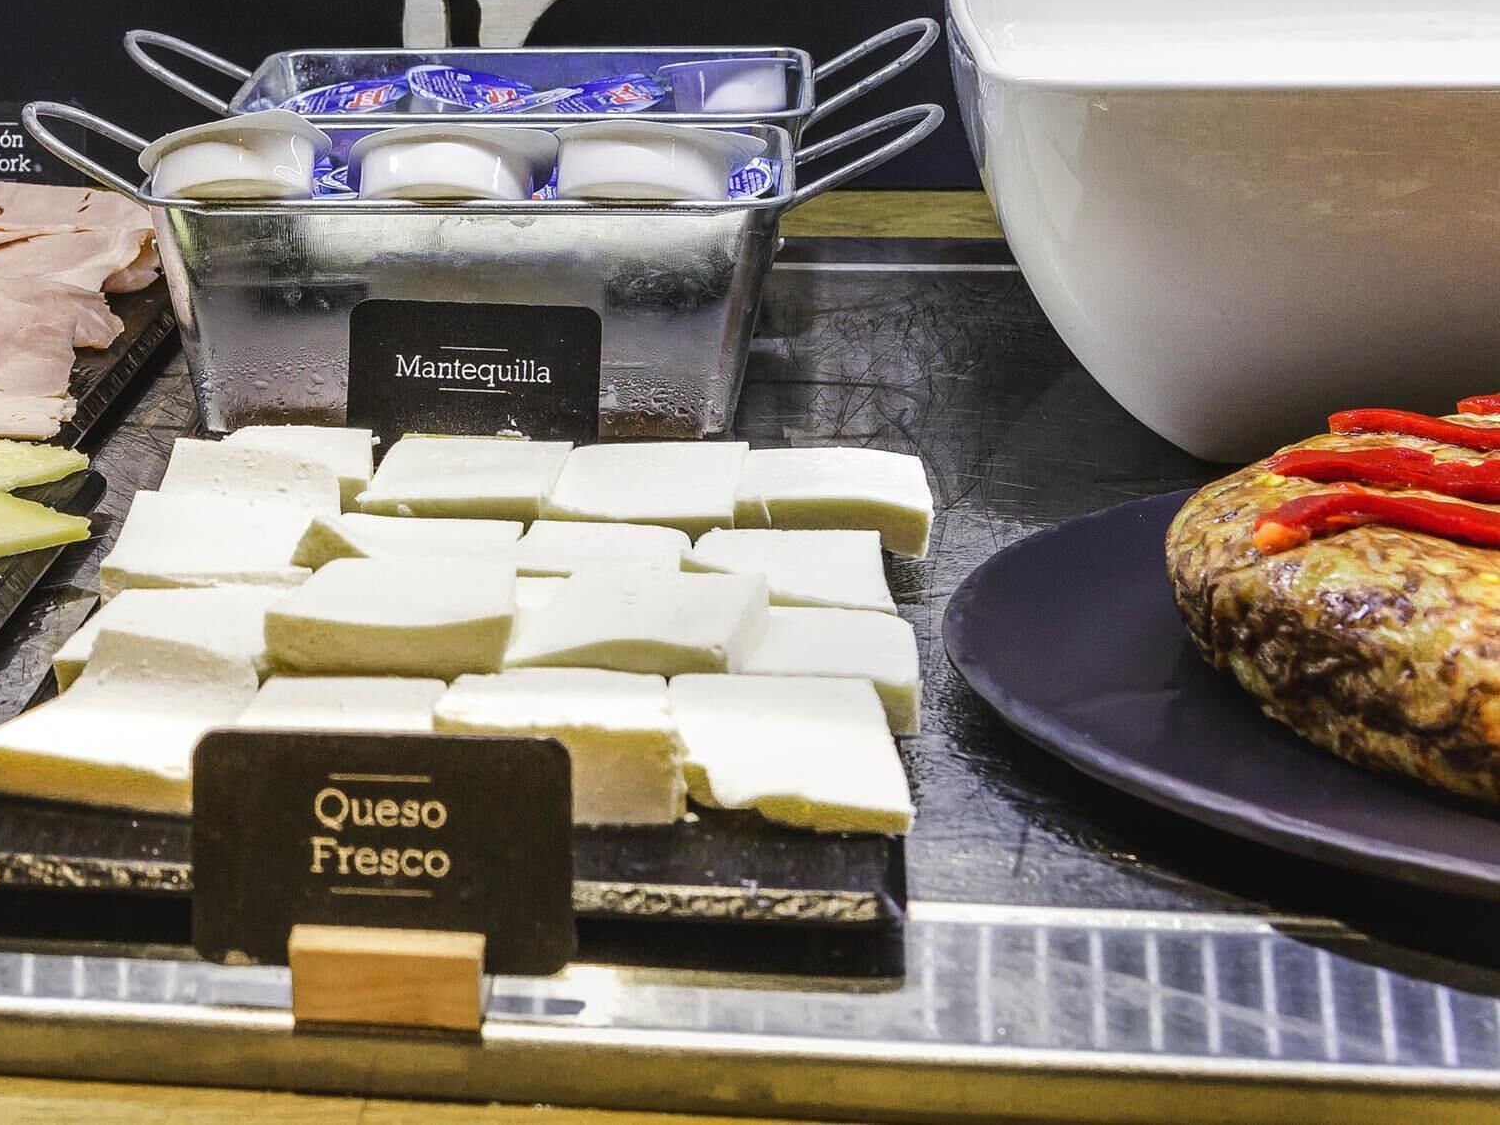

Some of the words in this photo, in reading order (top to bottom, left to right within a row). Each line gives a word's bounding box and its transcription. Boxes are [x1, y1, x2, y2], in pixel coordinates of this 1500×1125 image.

[395, 354, 552, 388] Mantequilla
[313, 787, 448, 832] Queso
[309, 835, 451, 878] Fresco
